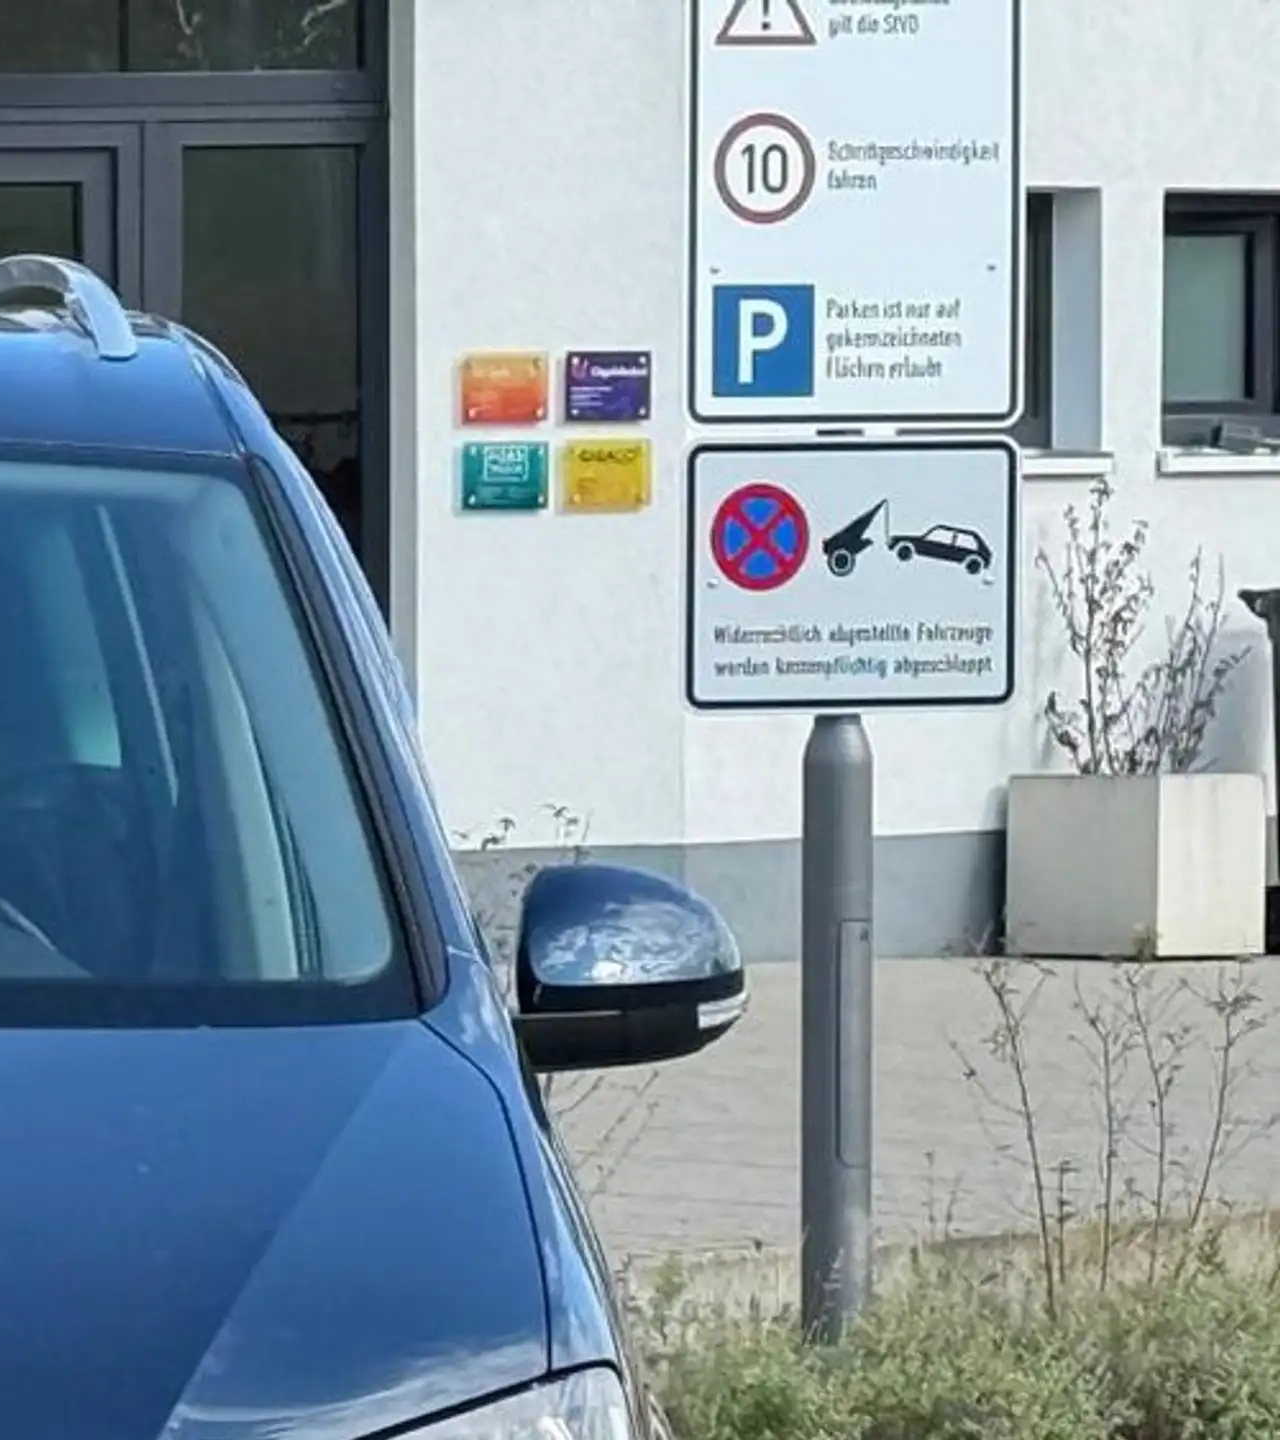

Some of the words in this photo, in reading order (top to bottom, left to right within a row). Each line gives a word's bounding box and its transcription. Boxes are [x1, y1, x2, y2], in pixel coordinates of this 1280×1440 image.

[739, 143, 789, 194] 10
[826, 169, 877, 190] fahren
[826, 299, 880, 320] Parken
[883, 299, 903, 319] ist
[737, 298, 789, 384] P
[916, 622, 994, 645] Fahrzeuge
